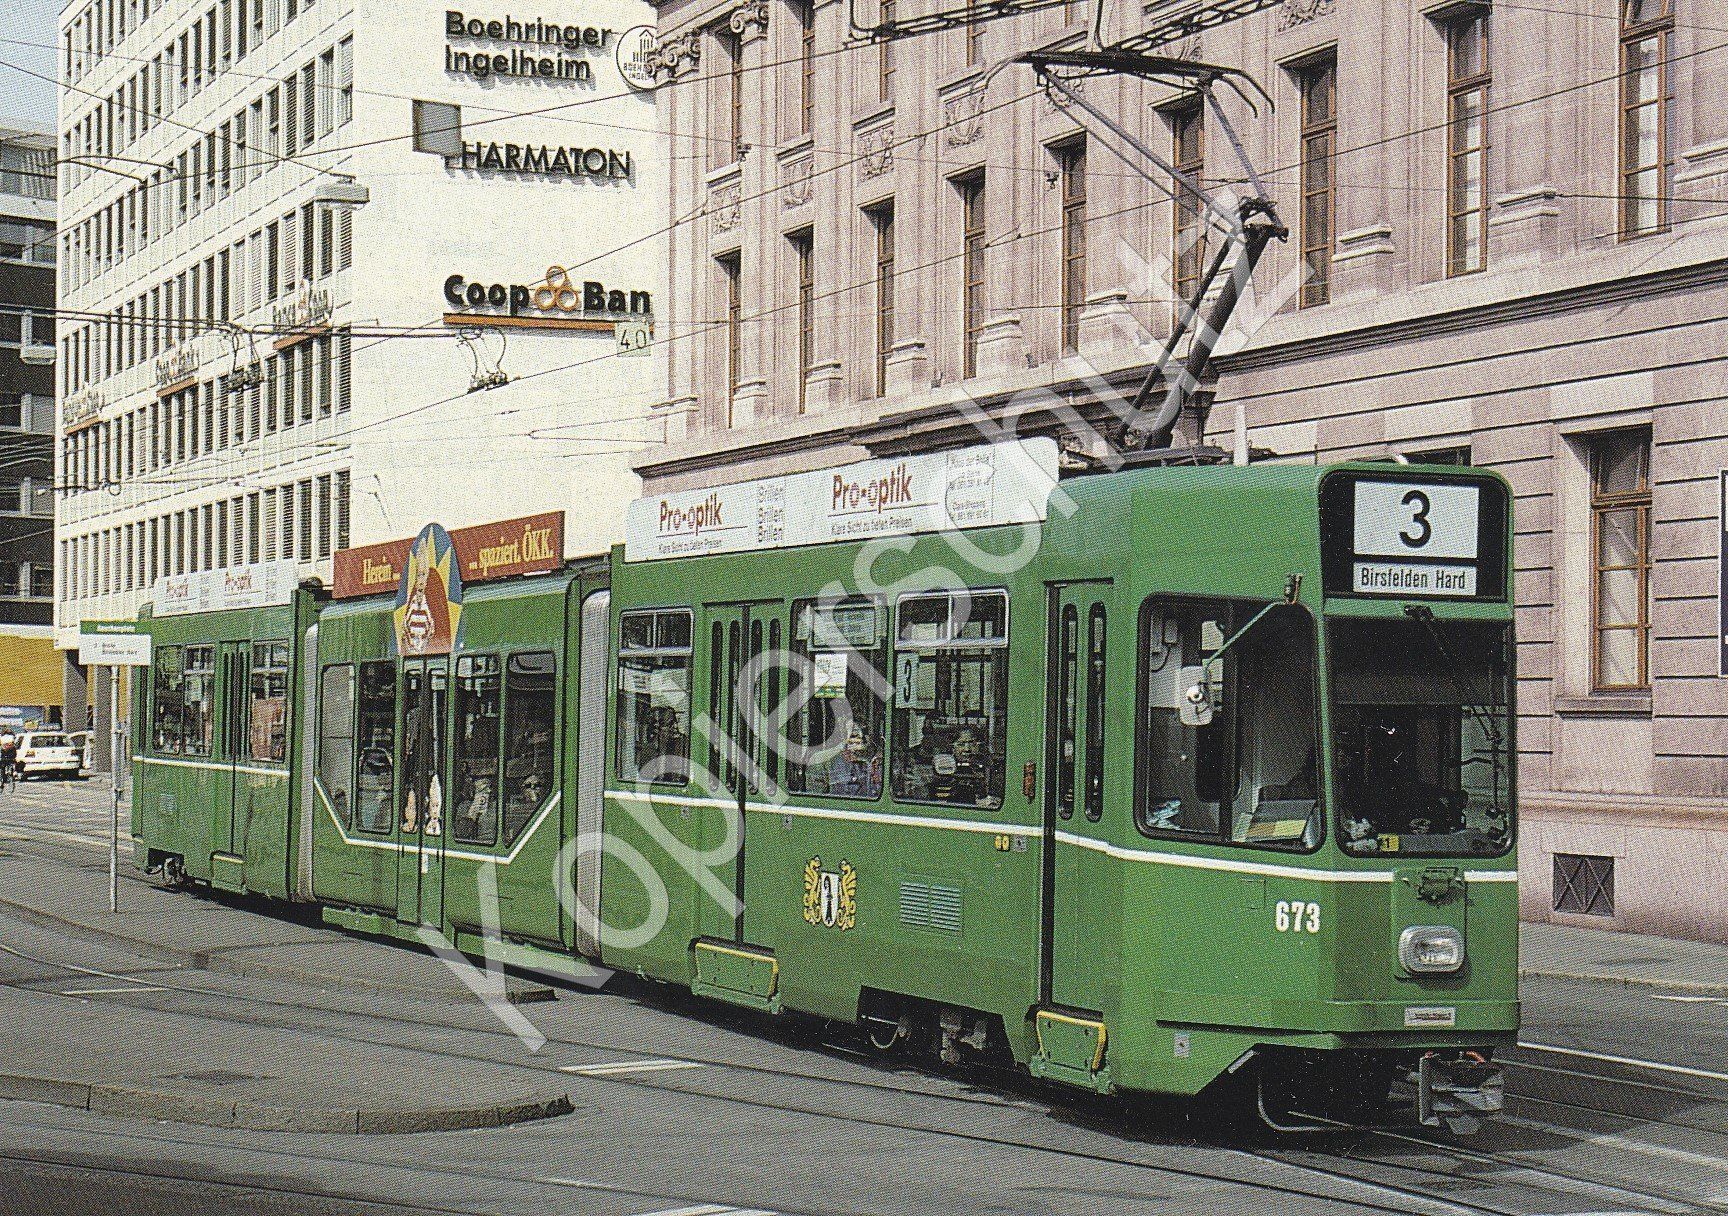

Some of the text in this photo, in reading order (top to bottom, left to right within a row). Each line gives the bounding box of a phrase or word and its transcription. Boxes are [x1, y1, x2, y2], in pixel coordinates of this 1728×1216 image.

[445, 10, 612, 49] Boehringer
[445, 44, 592, 78] Ingelheim
[444, 141, 630, 178] HARMATON
[444, 274, 651, 316] Coop Ban
[620, 329, 647, 349] 40
[1400, 489, 1432, 549] 3
[1361, 567, 1466, 589] Birsfelden Hard
[903, 657, 912, 703] 3
[1275, 900, 1321, 934] 673
